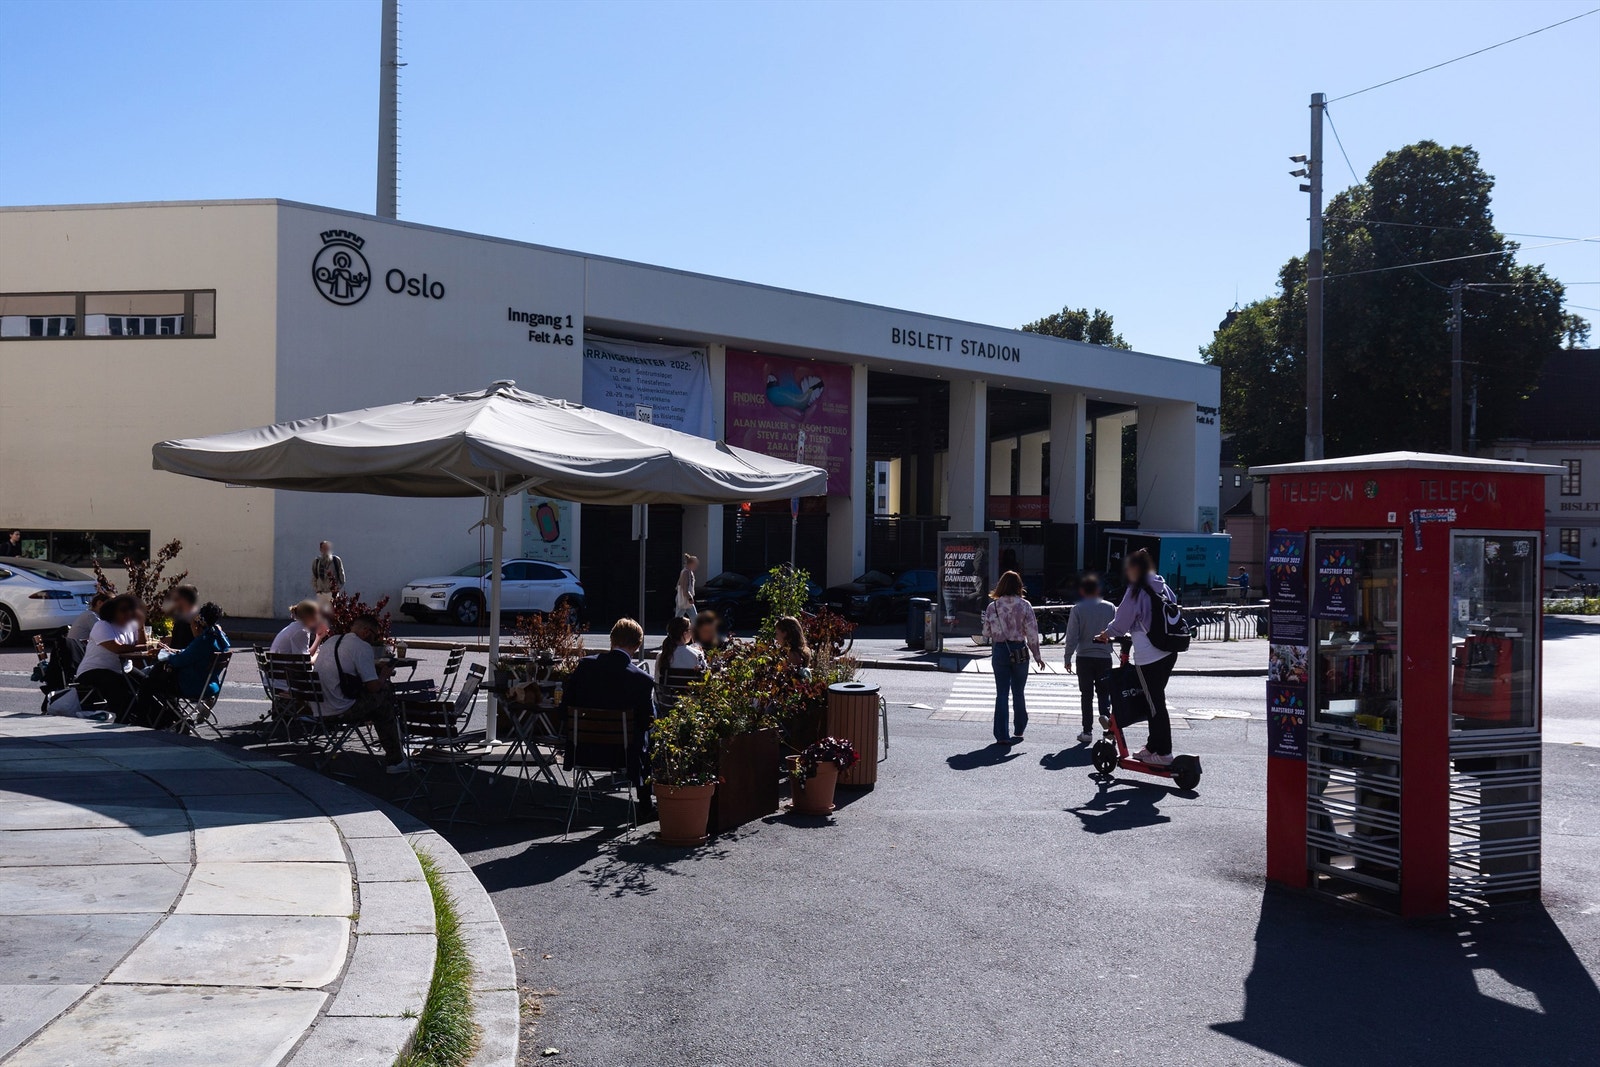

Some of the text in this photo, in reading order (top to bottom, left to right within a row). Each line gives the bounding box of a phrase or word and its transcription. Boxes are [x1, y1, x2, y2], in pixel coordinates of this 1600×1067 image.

[386, 268, 444, 299] Oslo
[508, 307, 573, 329] Inngang 1
[529, 330, 573, 345] Felt A-G
[892, 328, 1020, 363] BISLETT STADION
[733, 418, 756, 428] ALAN
[757, 420, 789, 430] WALKER
[757, 430, 779, 440] STEVE
[767, 442, 824, 454] ZARA LASSON
[1281, 481, 1353, 502] TELEFON
[1420, 480, 1497, 502] TELEFON
[944, 560, 966, 568] VELDIG
[944, 575, 977, 583] DANNENDE
